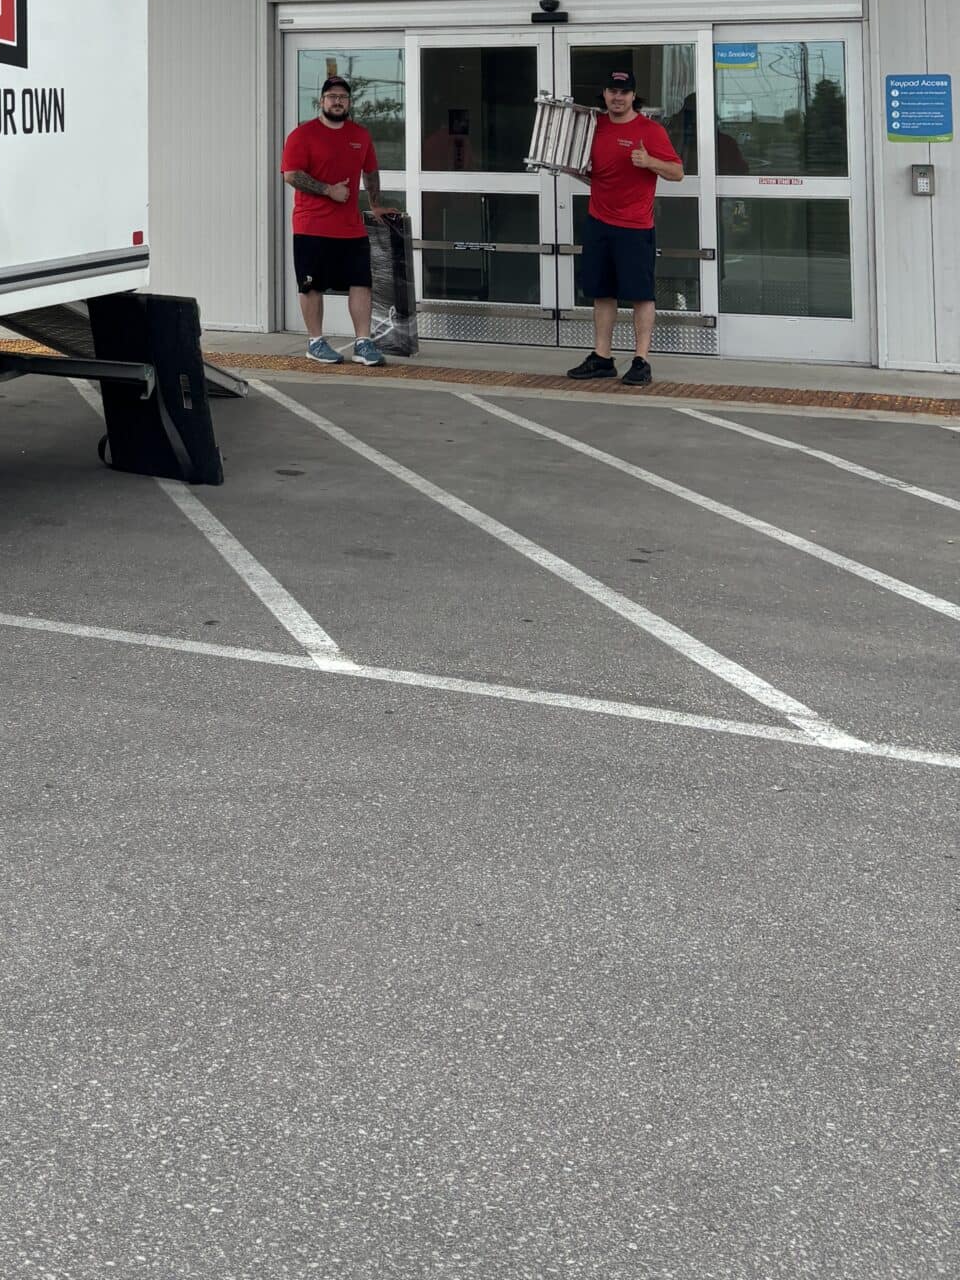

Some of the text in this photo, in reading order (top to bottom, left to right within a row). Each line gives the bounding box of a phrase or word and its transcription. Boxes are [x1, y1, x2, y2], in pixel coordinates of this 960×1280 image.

[890, 79, 948, 89] Keypad Access
[21, 87, 65, 135] OWN
